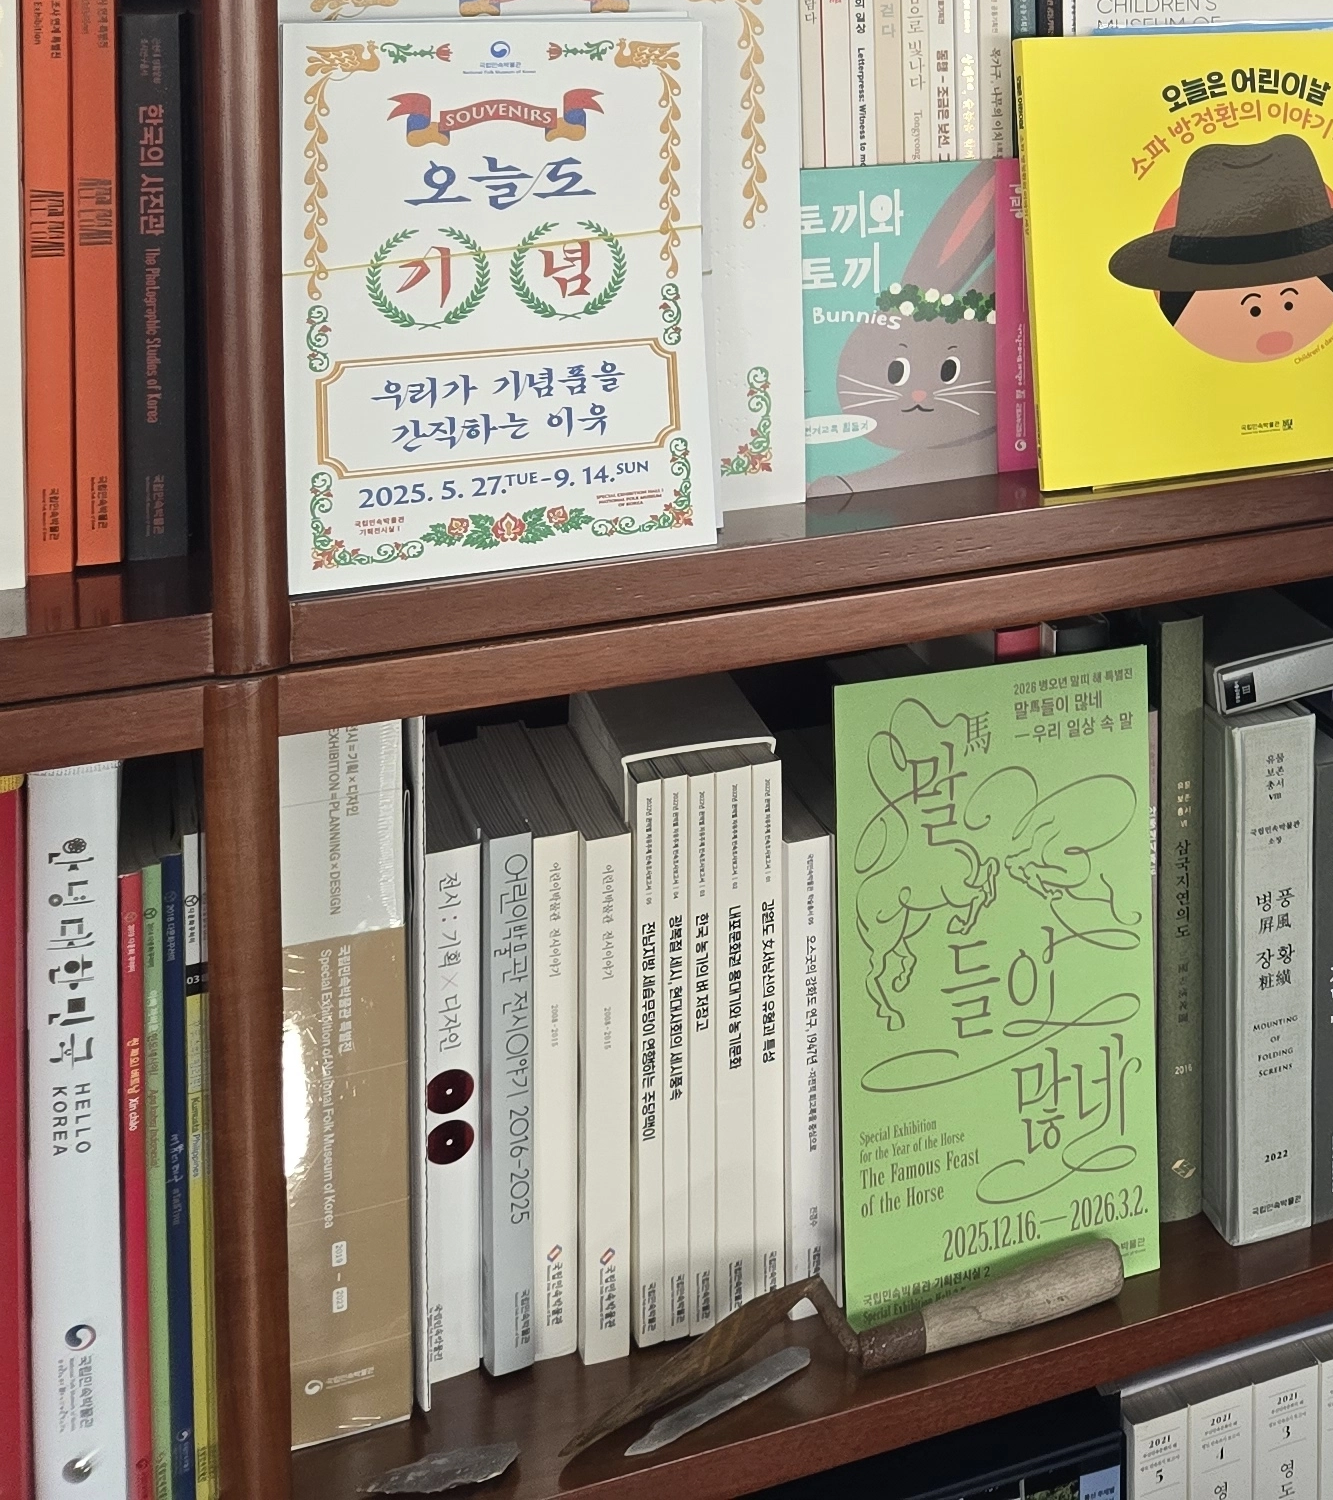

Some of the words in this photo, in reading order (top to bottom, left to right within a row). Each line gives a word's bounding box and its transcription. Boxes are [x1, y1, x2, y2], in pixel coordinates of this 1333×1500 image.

[32, 1, 43, 45] Exhibition
[1161, 70, 1228, 113] 오늘은
[1230, 67, 1332, 107] 어린이날
[445, 103, 553, 127] SOUVENIRS
[138, 103, 165, 168] 한국의
[1131, 134, 1171, 180] 소파
[1167, 99, 1262, 144] 방정환의
[1267, 101, 1333, 140] 이야기
[403, 155, 597, 211] 오늘도
[139, 173, 165, 237] 사진관
[800, 188, 905, 238] 토끼와
[801, 241, 881, 294] 토끼
[812, 306, 902, 331] Bunnies
[370, 374, 479, 411] 우리가
[492, 360, 626, 402] 기념품을
[1013, 681, 1037, 695] 2026
[1038, 678, 1068, 692] 병오년
[1070, 675, 1089, 689] 말띠
[1092, 671, 1102, 684] 해
[1104, 667, 1133, 683] 특별전
[695, 912, 709, 938] 한국
[319, 948, 333, 991] Special
[695, 940, 709, 977] 농가의
[337, 944, 352, 1019] 국립민속박물관
[696, 980, 709, 993] 벼
[320, 992, 334, 1047] Exhibition
[695, 995, 709, 1033] 저장고
[1252, 1015, 1299, 1033] MOUNTING
[338, 1021, 353, 1053] 특별전
[1257, 1047, 1294, 1063] FOLDING
[322, 1058, 335, 1107] National
[1258, 1063, 1294, 1078] SCREENS
[51, 1085, 69, 1157] KOREA
[73, 1082, 93, 1155] HELLO
[323, 1108, 335, 1132] Folk
[859, 1126, 891, 1147] Special
[892, 1117, 938, 1141] Exhibition
[323, 1134, 335, 1181] Museum
[859, 1168, 885, 1190] The
[890, 1158, 941, 1185] Famous
[945, 1147, 980, 1171] Feast
[1264, 1150, 1289, 1164] 2022
[324, 1182, 336, 1194] of
[860, 1200, 877, 1218] of
[879, 1195, 902, 1214] the
[905, 1184, 945, 1209] Horse
[323, 1195, 336, 1228] Korea
[1277, 1392, 1299, 1406] 2021
[1210, 1412, 1232, 1426] 2021
[1149, 1434, 1172, 1448] 2021
